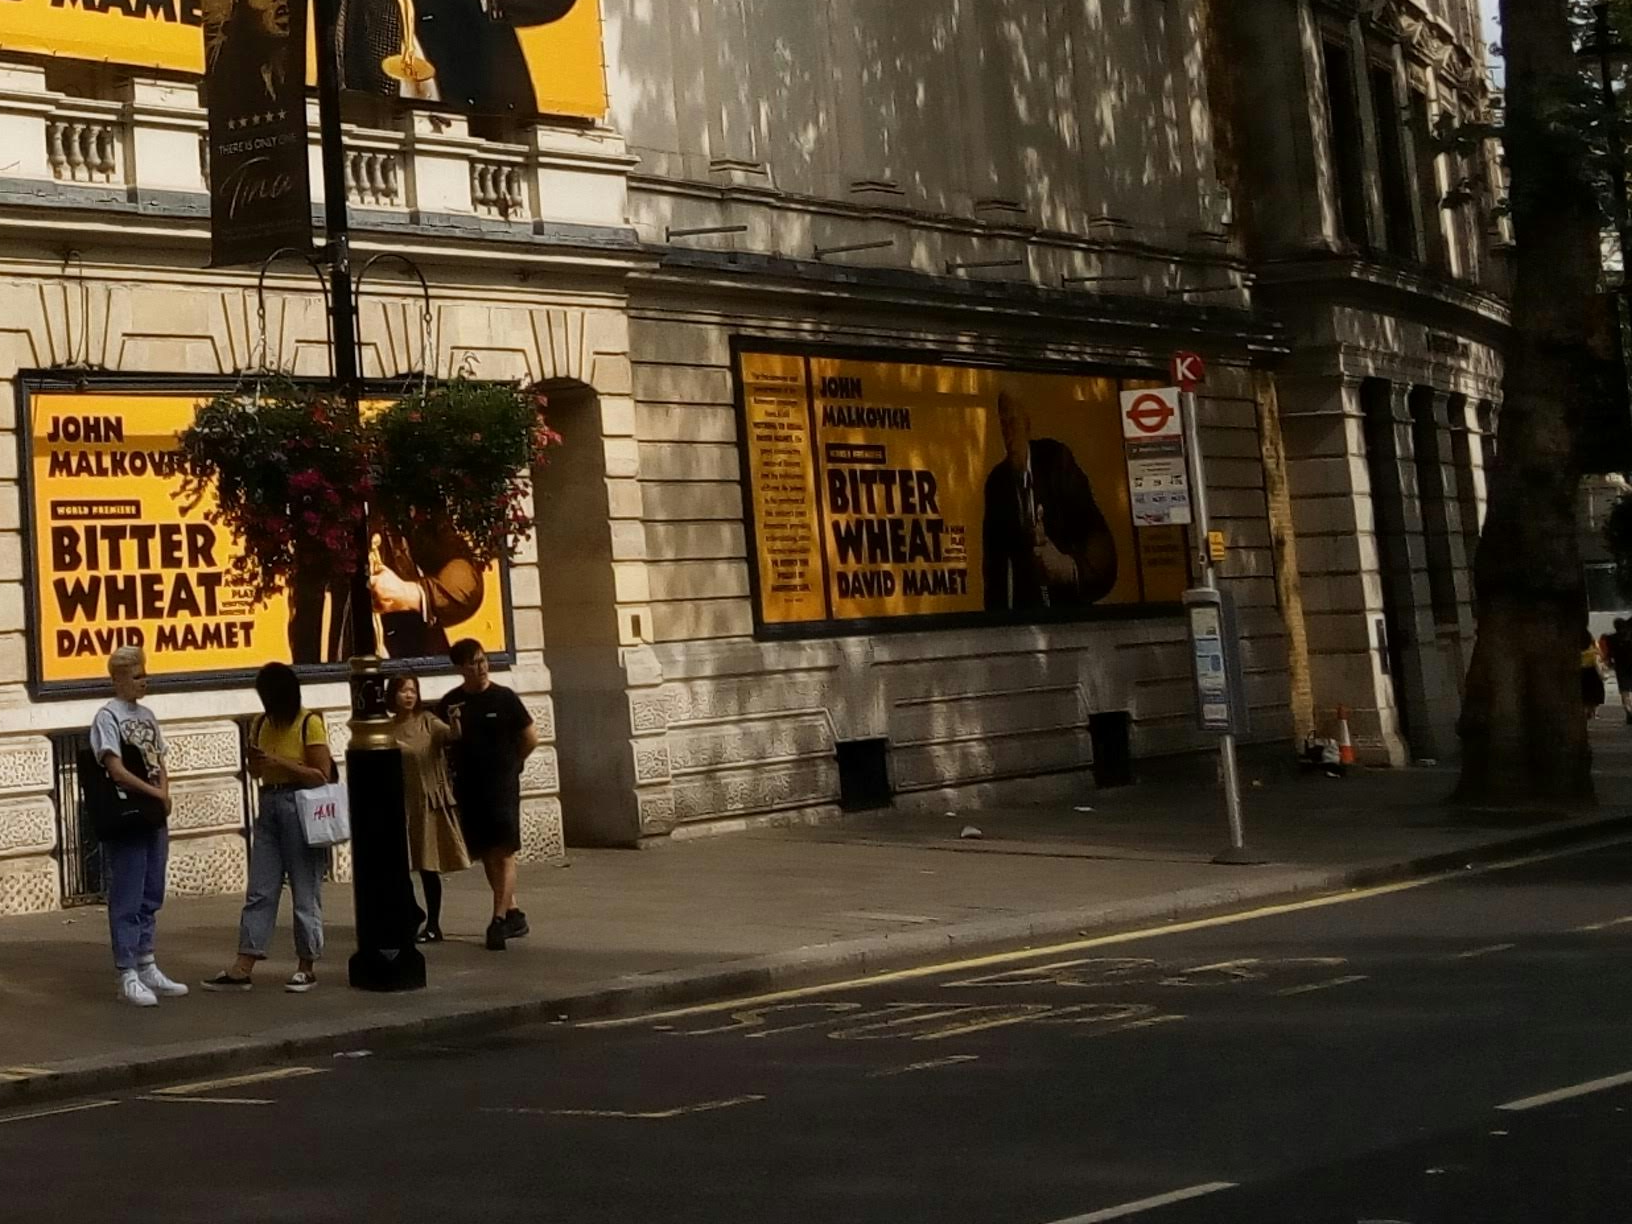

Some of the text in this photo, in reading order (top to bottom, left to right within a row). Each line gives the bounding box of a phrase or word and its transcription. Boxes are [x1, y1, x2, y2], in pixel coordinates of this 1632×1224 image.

[1176, 357, 1196, 381] K
[820, 376, 863, 399] JOHN
[47, 416, 124, 443] JOHN
[822, 404, 911, 430] MALKOVICH
[827, 468, 940, 515] BITTER
[51, 523, 218, 572] BITTER
[831, 518, 944, 564] WHEAT
[53, 572, 222, 623] WHEAT
[836, 569, 968, 599] DAVID MAMET
[56, 621, 255, 658] DAVID MAMET
